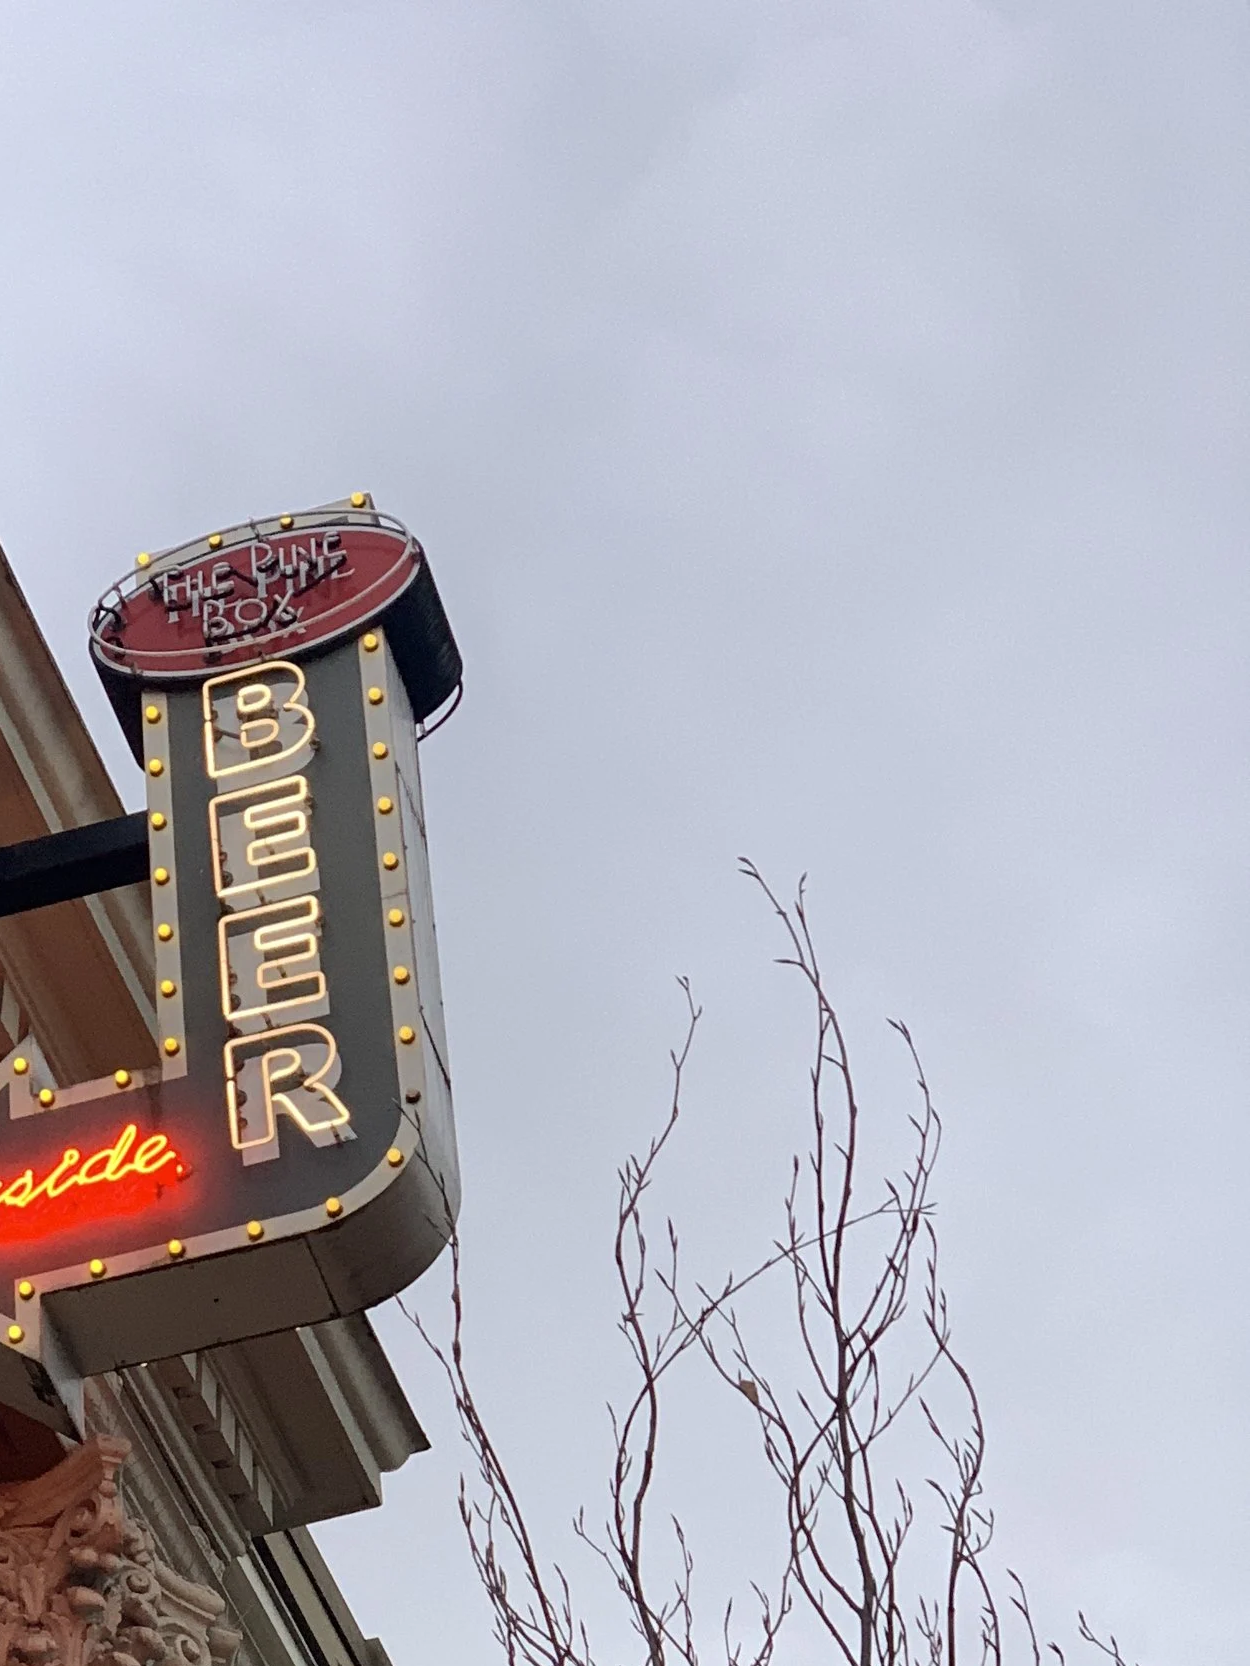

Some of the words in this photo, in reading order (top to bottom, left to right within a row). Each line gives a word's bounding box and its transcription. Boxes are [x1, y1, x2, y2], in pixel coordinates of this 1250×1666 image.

[160, 562, 235, 621] THE
[251, 531, 353, 597] PINE
[203, 591, 305, 645] BOX
[202, 660, 357, 1160] BEER
